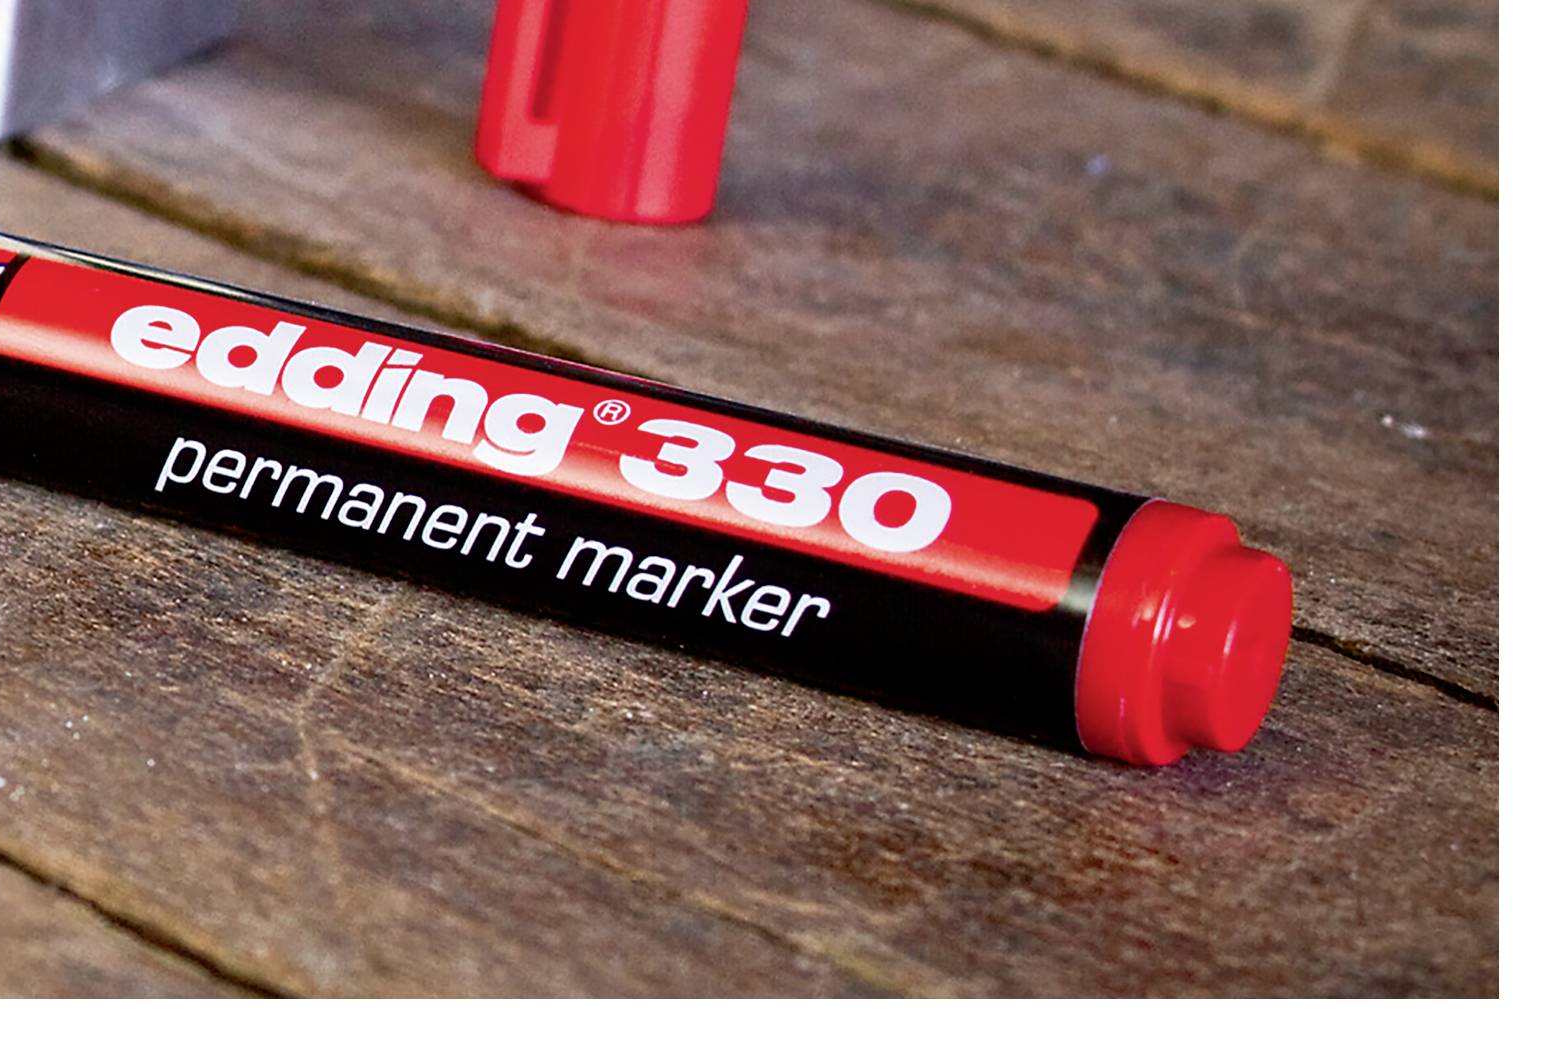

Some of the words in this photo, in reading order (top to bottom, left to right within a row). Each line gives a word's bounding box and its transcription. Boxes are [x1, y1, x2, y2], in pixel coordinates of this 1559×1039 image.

[153, 436, 547, 570] permanent
[555, 535, 832, 639] marker
[618, 418, 953, 554] 330
